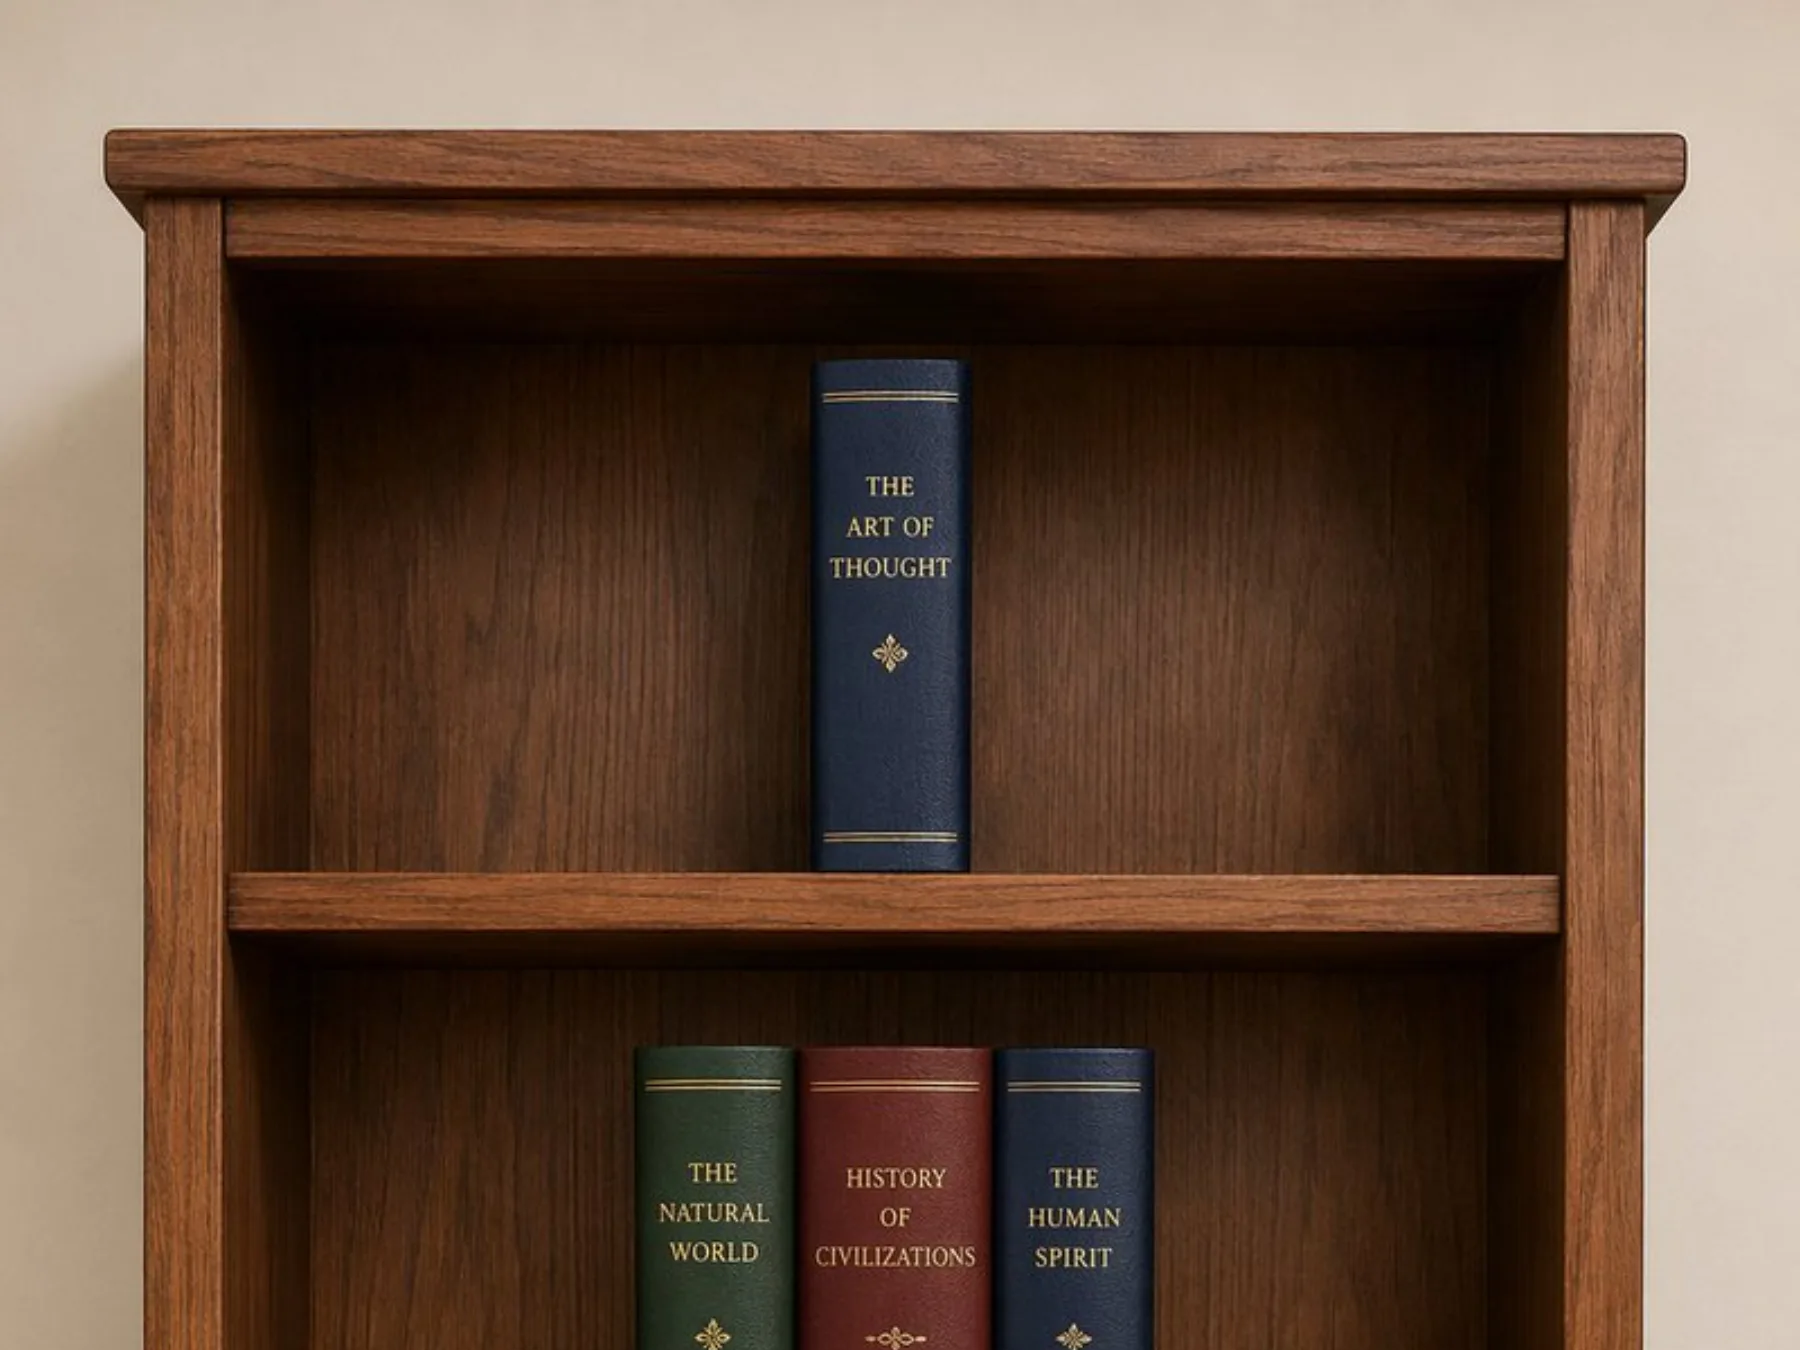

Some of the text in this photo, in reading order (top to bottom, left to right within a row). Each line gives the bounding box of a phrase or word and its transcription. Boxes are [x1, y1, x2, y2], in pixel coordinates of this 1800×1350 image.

[865, 475, 915, 498] THE
[846, 515, 935, 538] ART OF
[829, 556, 953, 579] THOUGHT
[687, 1162, 738, 1184] THE
[847, 1167, 947, 1189] HISTORY
[1049, 1167, 1100, 1189] THE
[659, 1202, 770, 1224] NATURAL
[879, 1207, 912, 1228] OF
[1028, 1207, 1122, 1229] HUMAN
[669, 1241, 759, 1264] WORLD
[816, 1246, 976, 1268] CIVILIZATIONS
[1035, 1246, 1114, 1269] SPIRIT
